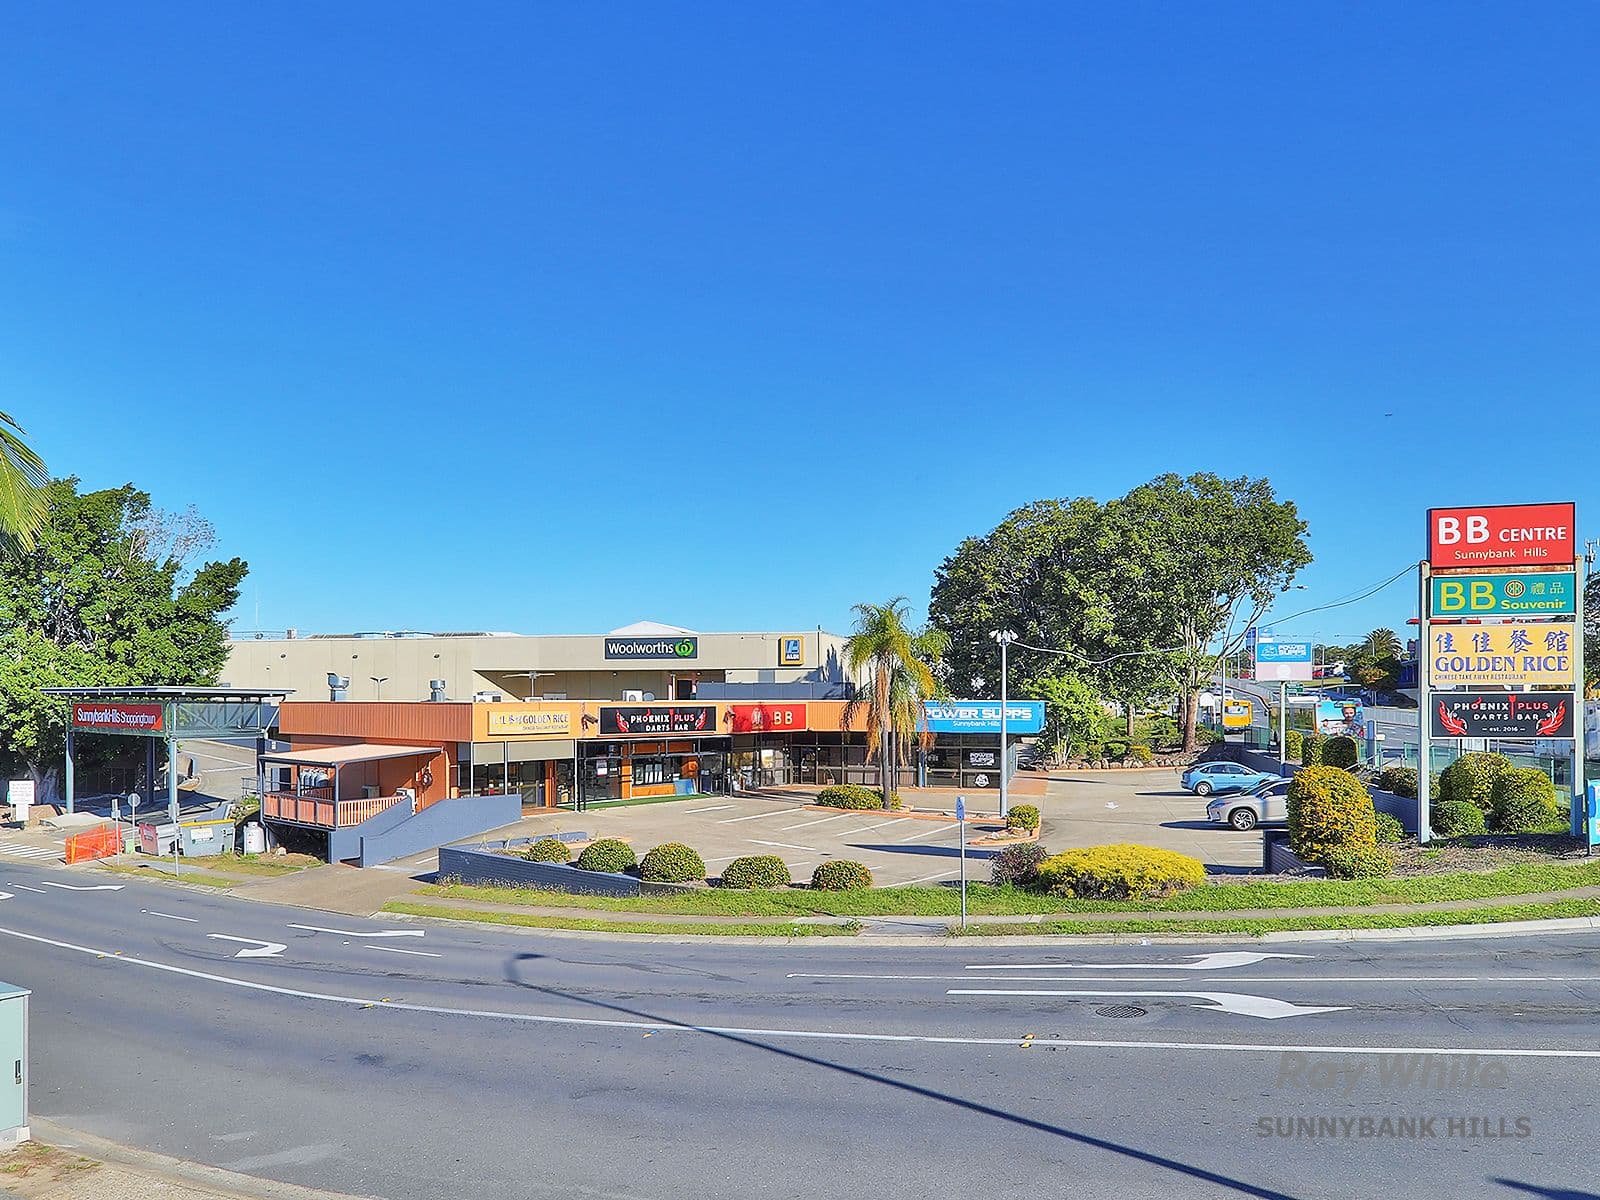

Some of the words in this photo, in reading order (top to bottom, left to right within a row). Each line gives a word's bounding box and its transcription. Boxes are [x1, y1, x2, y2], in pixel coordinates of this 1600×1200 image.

[1438, 516, 1490, 545] BB
[1499, 526, 1567, 542] CENTRE
[1454, 548, 1517, 561] Sunnybank
[1523, 547, 1548, 557] Hills
[1440, 581, 1497, 611] BB
[1500, 599, 1567, 609] Souvenir
[1435, 629, 1570, 654] 佳佳餐館
[608, 642, 674, 654] Woolworths
[1435, 656, 1516, 672] GOLDEN
[1522, 655, 1570, 671] RICE
[1453, 702, 1509, 711] PHOENIX
[1517, 702, 1549, 711] PLUS
[552, 713, 568, 723] RICE
[630, 714, 670, 724] PHOENIX
[674, 714, 695, 722] PLUS
[773, 711, 793, 725] BB
[1473, 713, 1509, 721] DARTS
[1517, 713, 1539, 721] BAR
[645, 723, 671, 732] DARTS
[674, 723, 689, 731] BAR
[952, 720, 986, 728] Sunnybank
